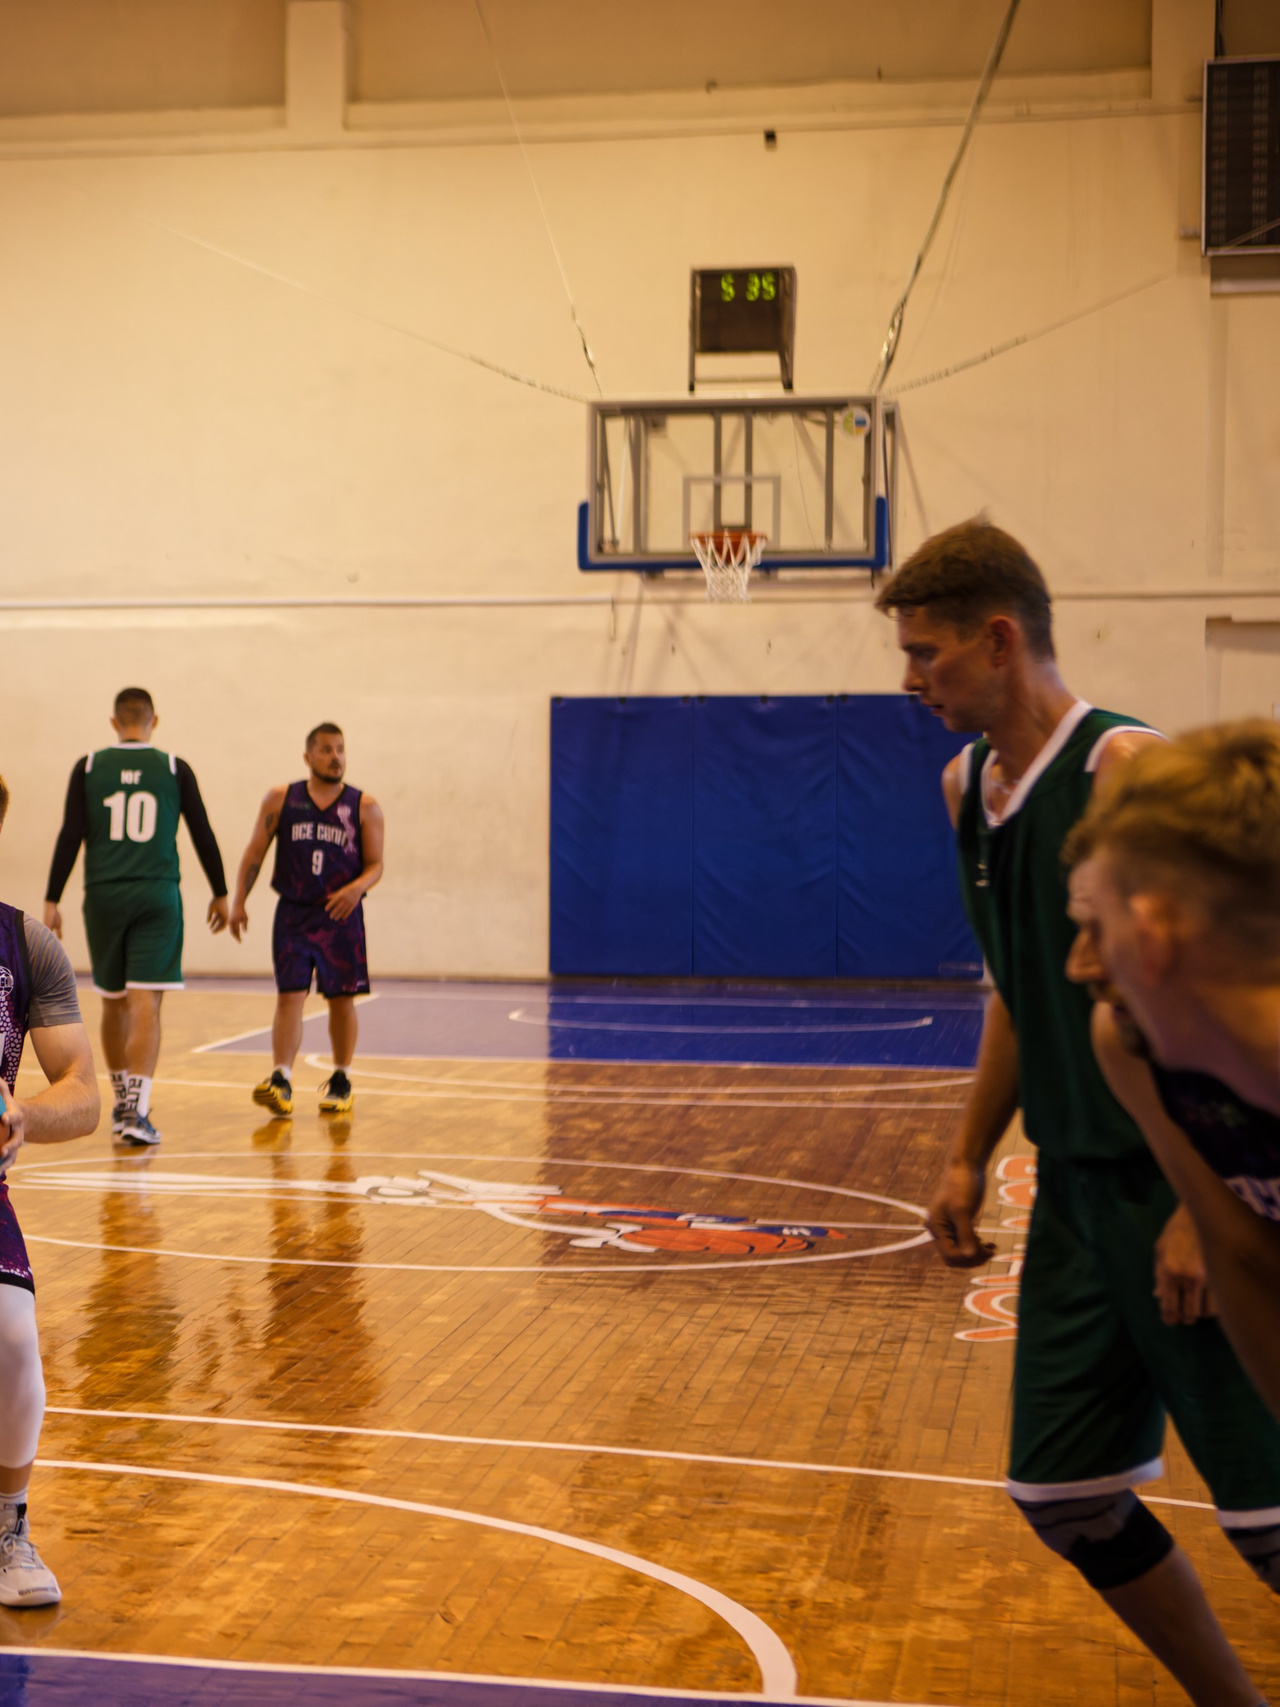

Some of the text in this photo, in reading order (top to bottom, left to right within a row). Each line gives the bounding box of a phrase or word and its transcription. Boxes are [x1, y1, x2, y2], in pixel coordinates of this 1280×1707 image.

[721, 273, 775, 301] 5 35
[103, 791, 157, 843] 10
[311, 849, 324, 876] 9
